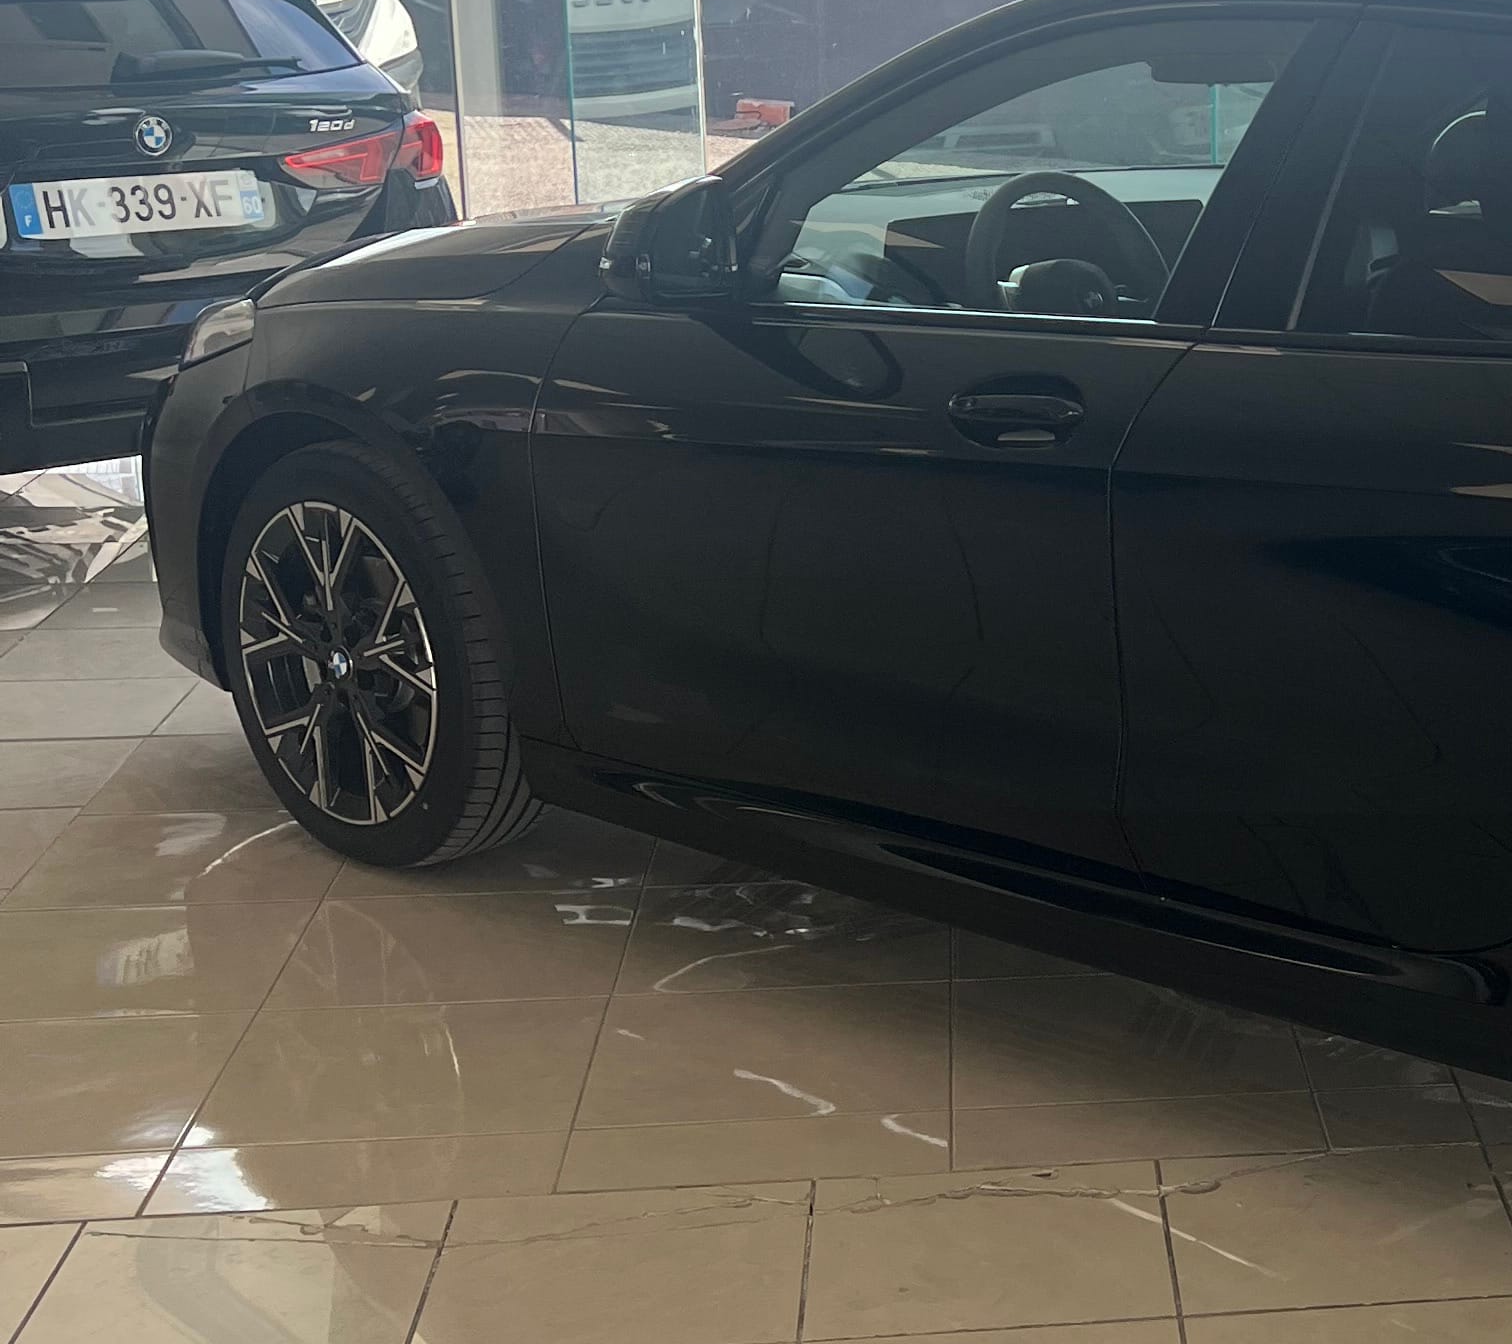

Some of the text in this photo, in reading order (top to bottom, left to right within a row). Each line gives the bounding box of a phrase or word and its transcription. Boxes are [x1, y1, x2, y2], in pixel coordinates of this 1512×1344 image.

[310, 119, 355, 132] 120d
[42, 179, 233, 229] HK-339-XF
[242, 195, 263, 214] 60
